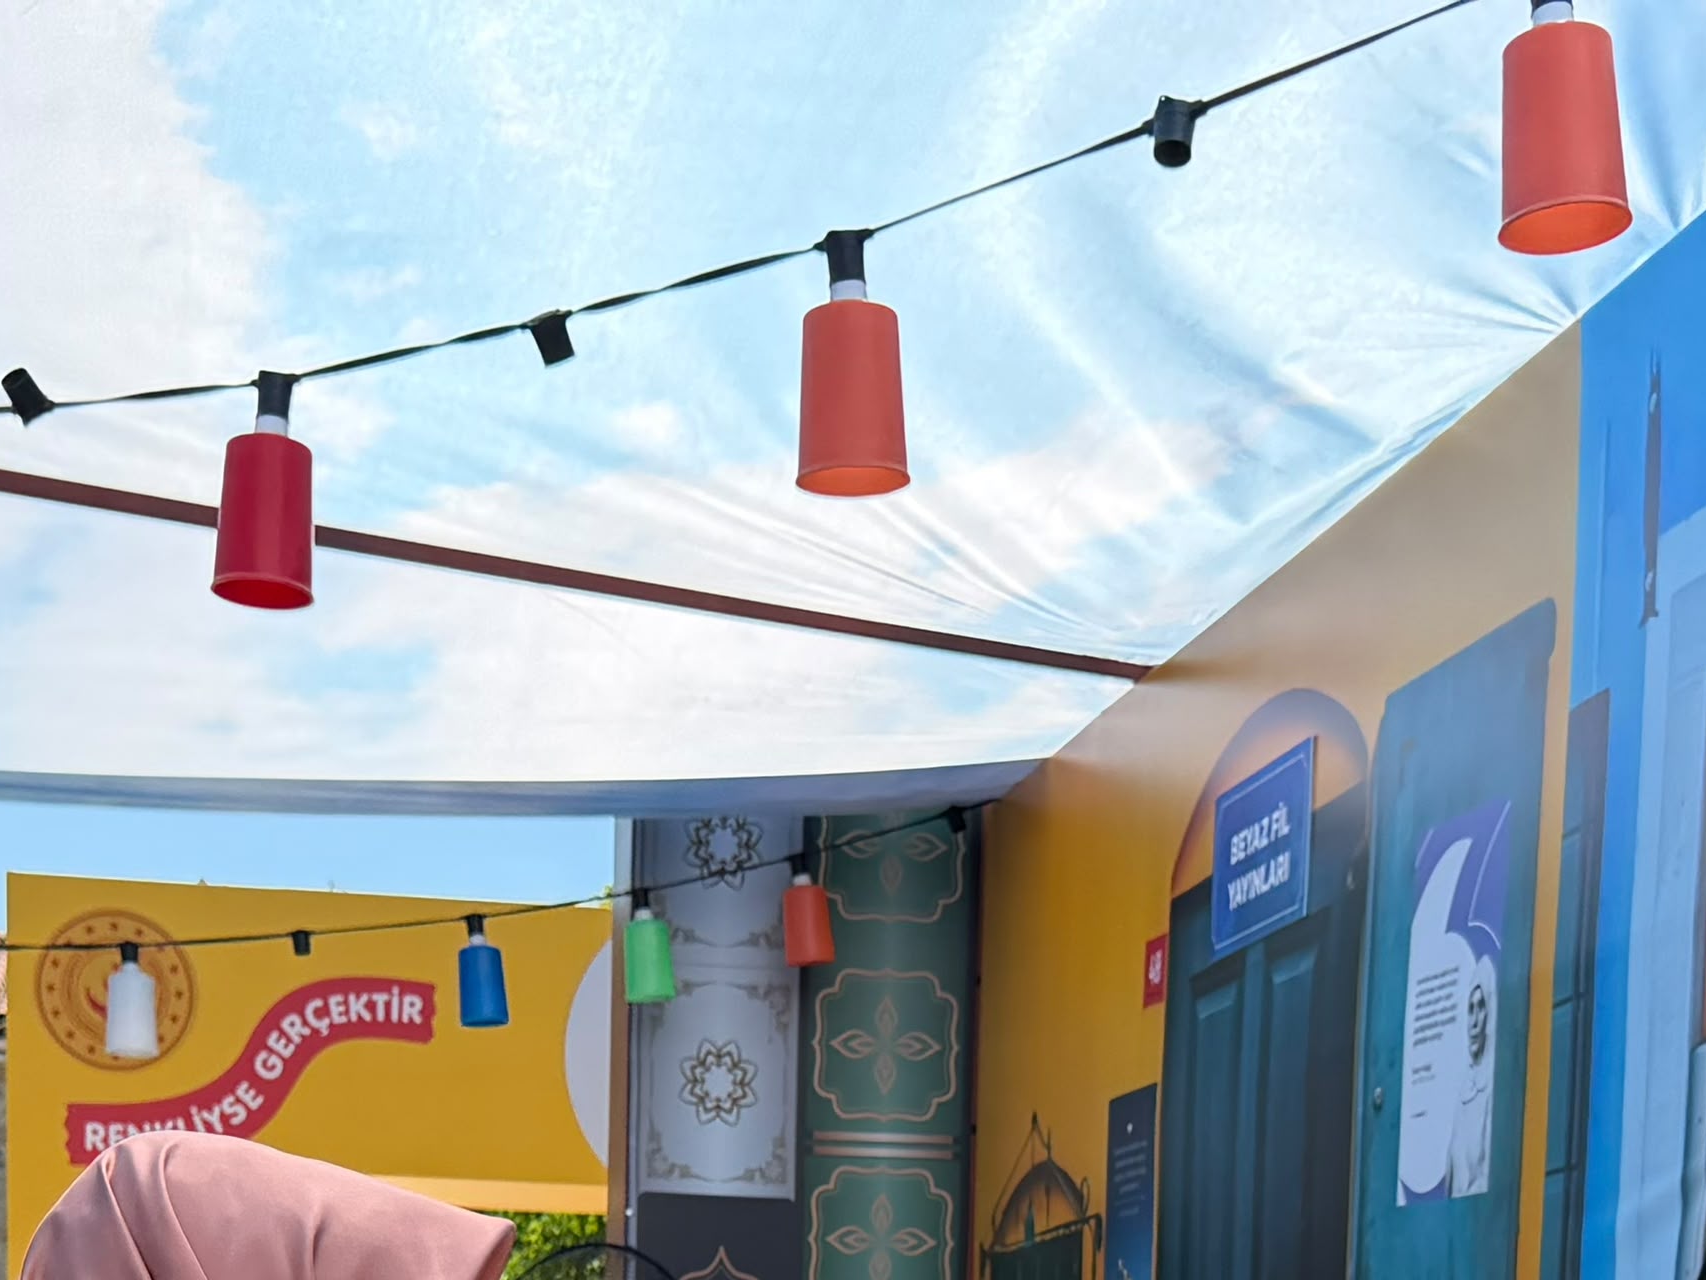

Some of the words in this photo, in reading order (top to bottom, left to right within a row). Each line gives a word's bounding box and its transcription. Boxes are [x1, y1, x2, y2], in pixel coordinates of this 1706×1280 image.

[1230, 816, 1269, 865] BEYAZ
[1271, 801, 1291, 848] FİL
[1228, 853, 1290, 911] YAYINLARI
[255, 987, 424, 1079] GERÇEKTİR
